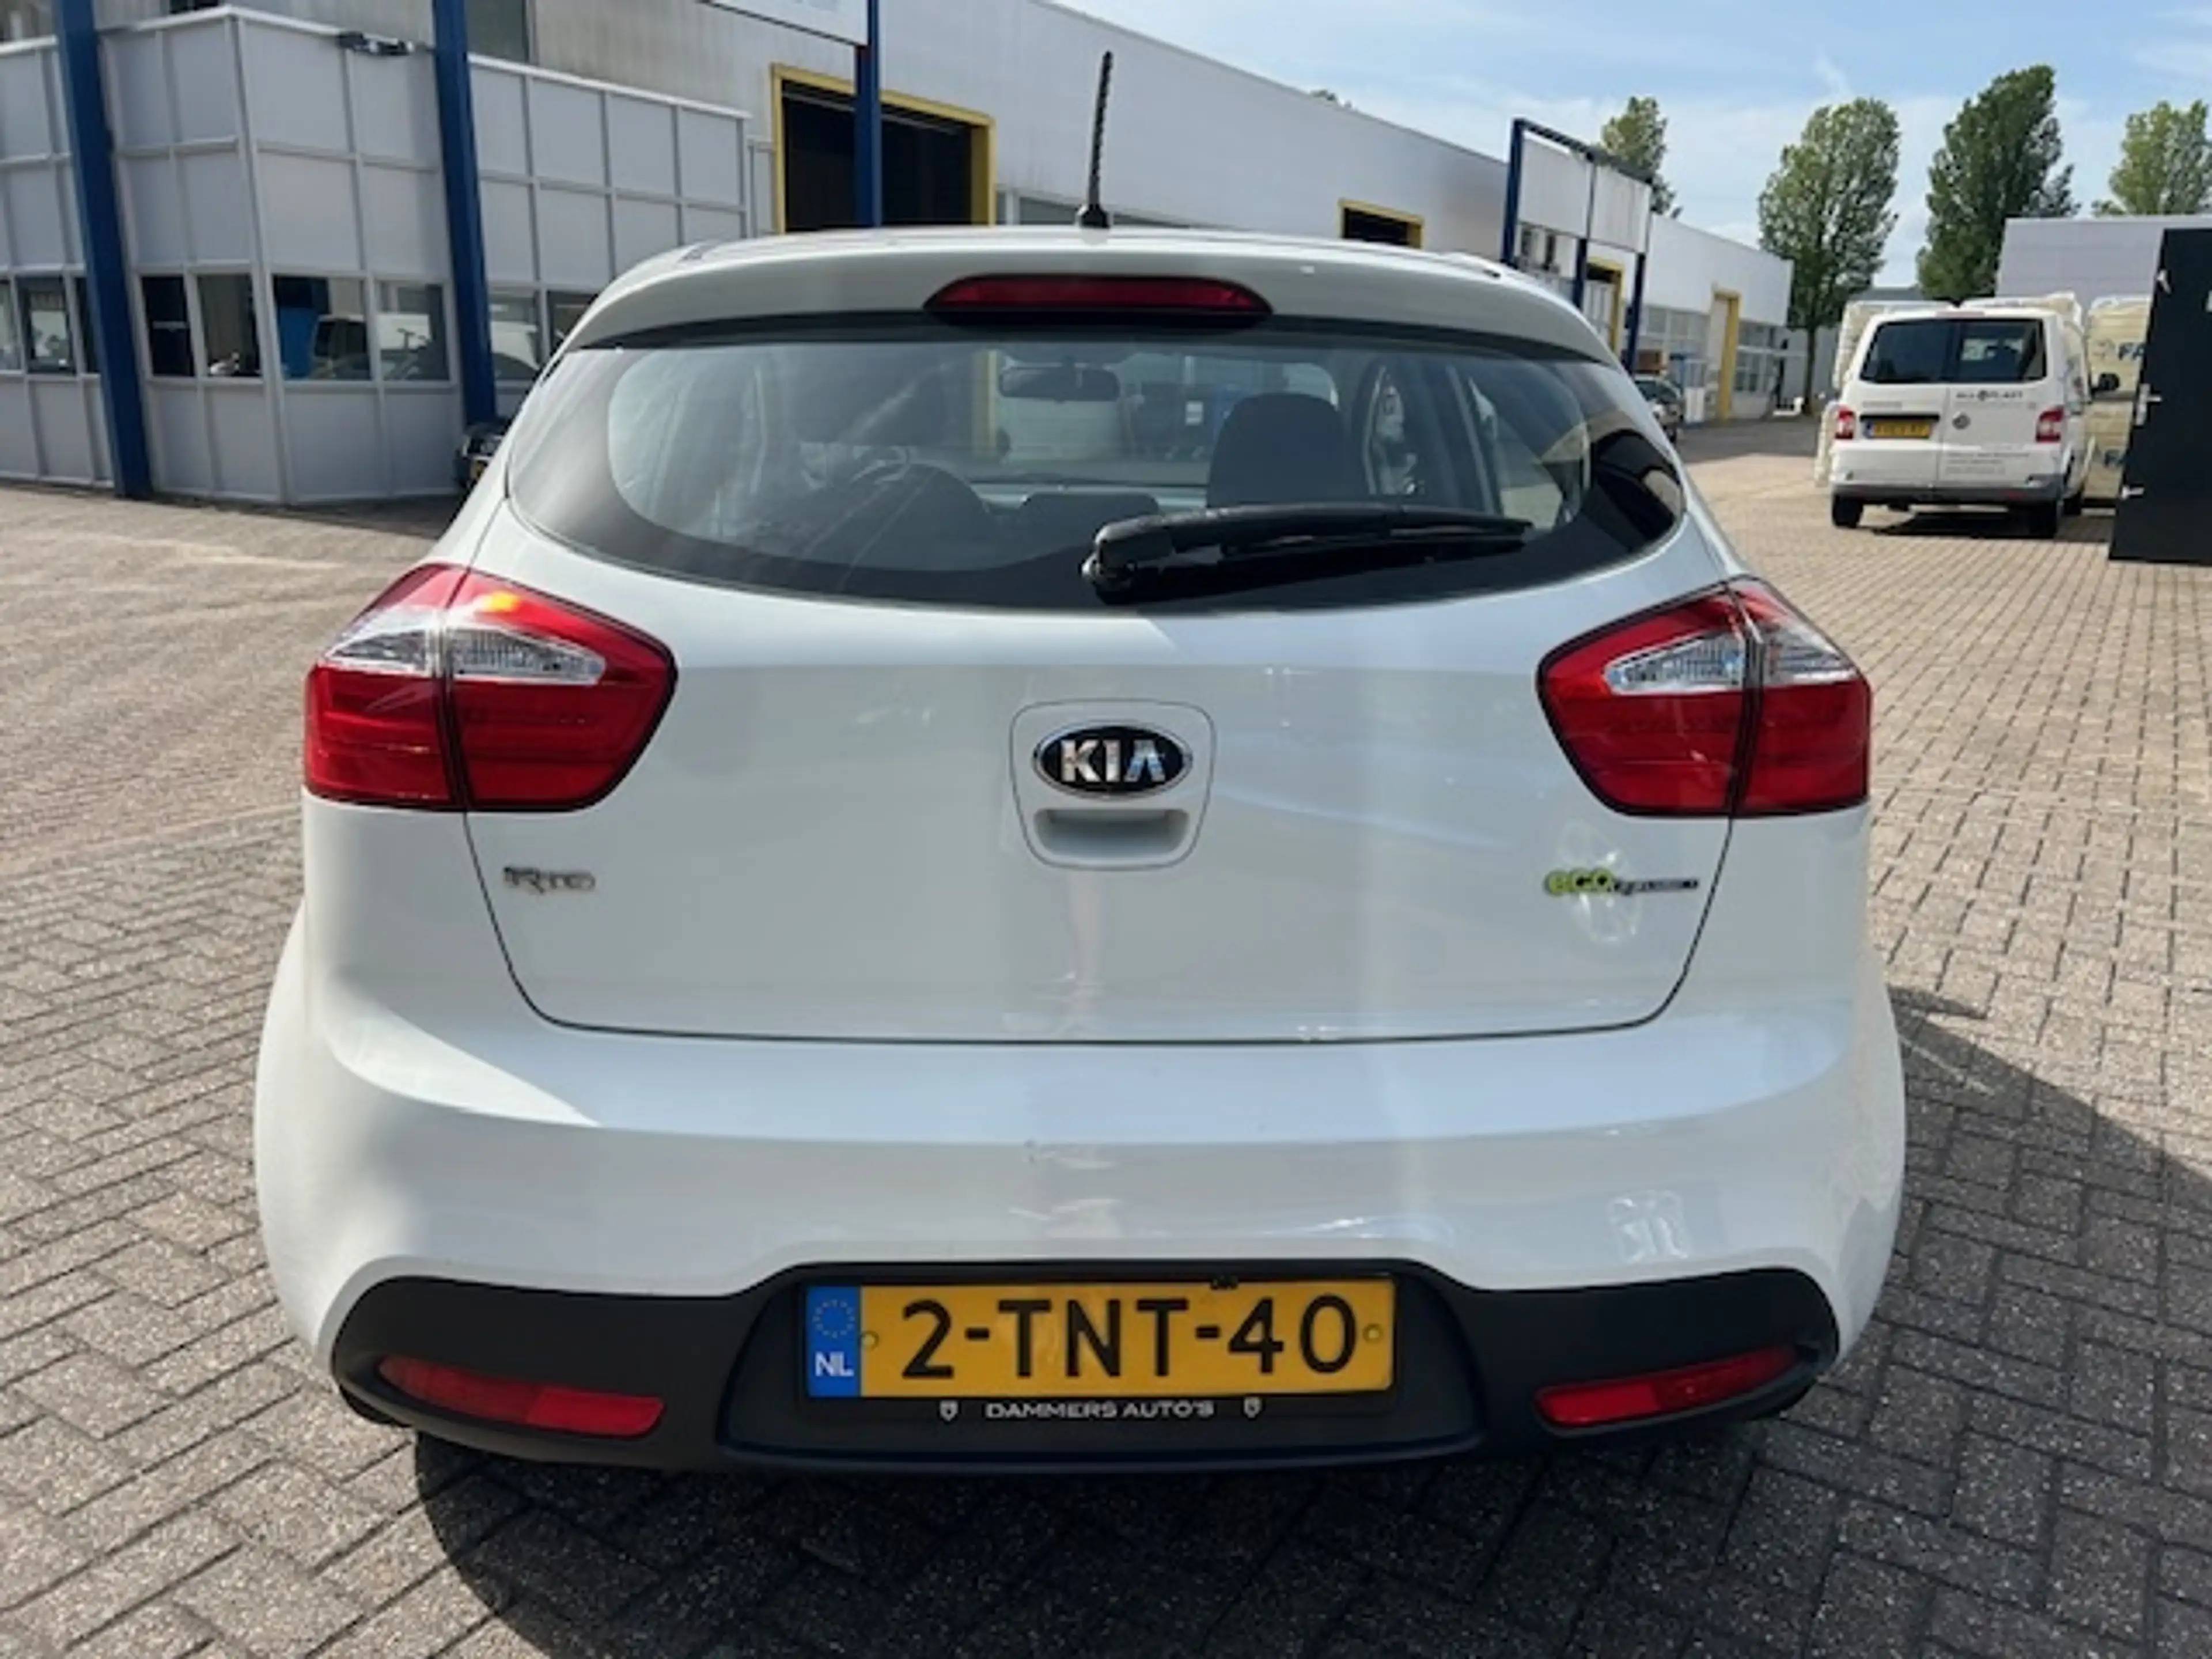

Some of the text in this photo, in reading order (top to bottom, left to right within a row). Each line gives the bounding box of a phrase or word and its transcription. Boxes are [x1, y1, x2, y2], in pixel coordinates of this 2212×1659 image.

[1060, 738, 1166, 782] KIA
[815, 1293, 1358, 1380] NL 2-TNT-40
[984, 1400, 1215, 1419] DAMMERS AUTO'S
